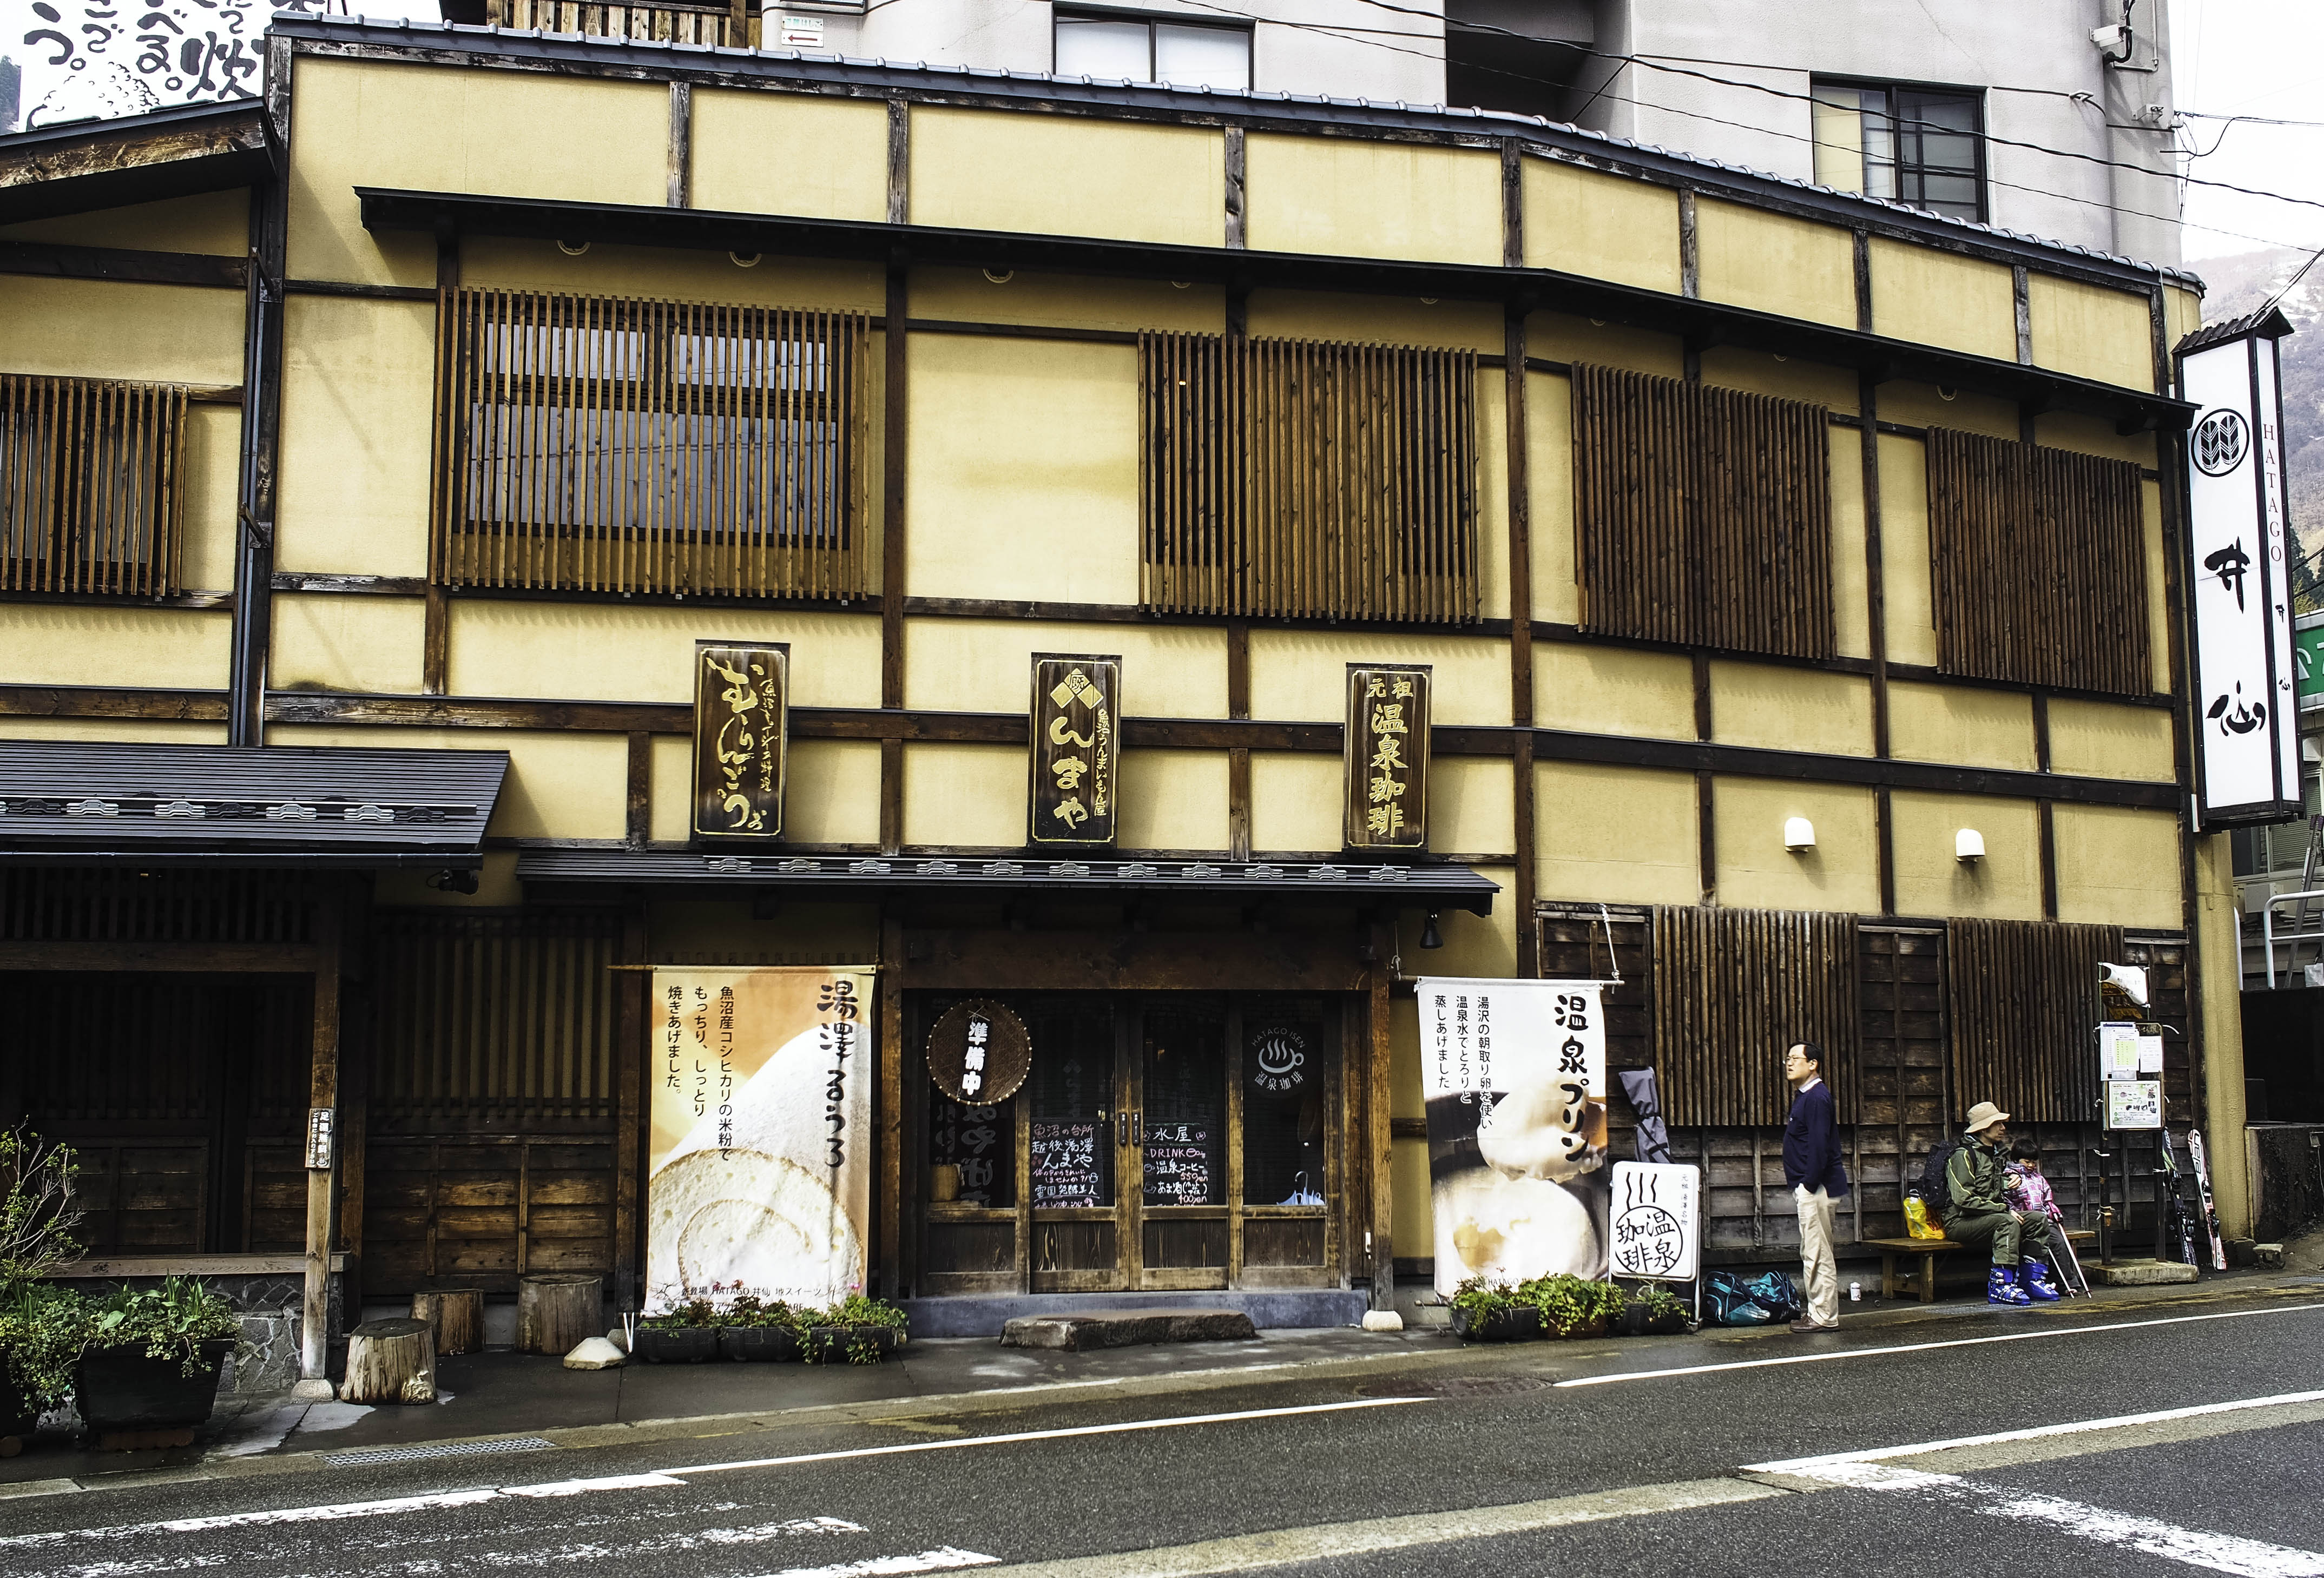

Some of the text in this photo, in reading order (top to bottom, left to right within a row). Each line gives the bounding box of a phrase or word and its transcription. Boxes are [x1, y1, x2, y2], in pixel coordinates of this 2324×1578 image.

[2262, 424, 2282, 563] HATAGO
[1366, 676, 1413, 699] 元祖
[1049, 716, 1094, 829] んまや
[1367, 703, 1408, 837] 温泉珈琲
[667, 986, 683, 1094] 焼きあげました。
[718, 986, 734, 1161] 魚沼産コシヒカリの米粉で
[962, 1021, 987, 1095] 準備中
[1251, 1027, 1306, 1048] HATAGO ISEN
[1434, 995, 1451, 1095] 蒸しあげました。
[1456, 995, 1472, 1104] 温泉水でとろりと
[1477, 996, 1493, 1130] 湯沢の朝取り卵を使い
[1254, 1070, 1304, 1091] 温泉珈琲
[1555, 994, 1589, 1162] 温泉プリン
[1034, 1123, 1094, 1139] 魚沼の台所
[1042, 1152, 1092, 1169] んまや
[1150, 1148, 1185, 1158] DRINK
[1153, 1126, 1191, 1141] 水屋
[1156, 1158, 1204, 1174] 温泉コーヒー
[712, 1288, 749, 1296] HATAGO
